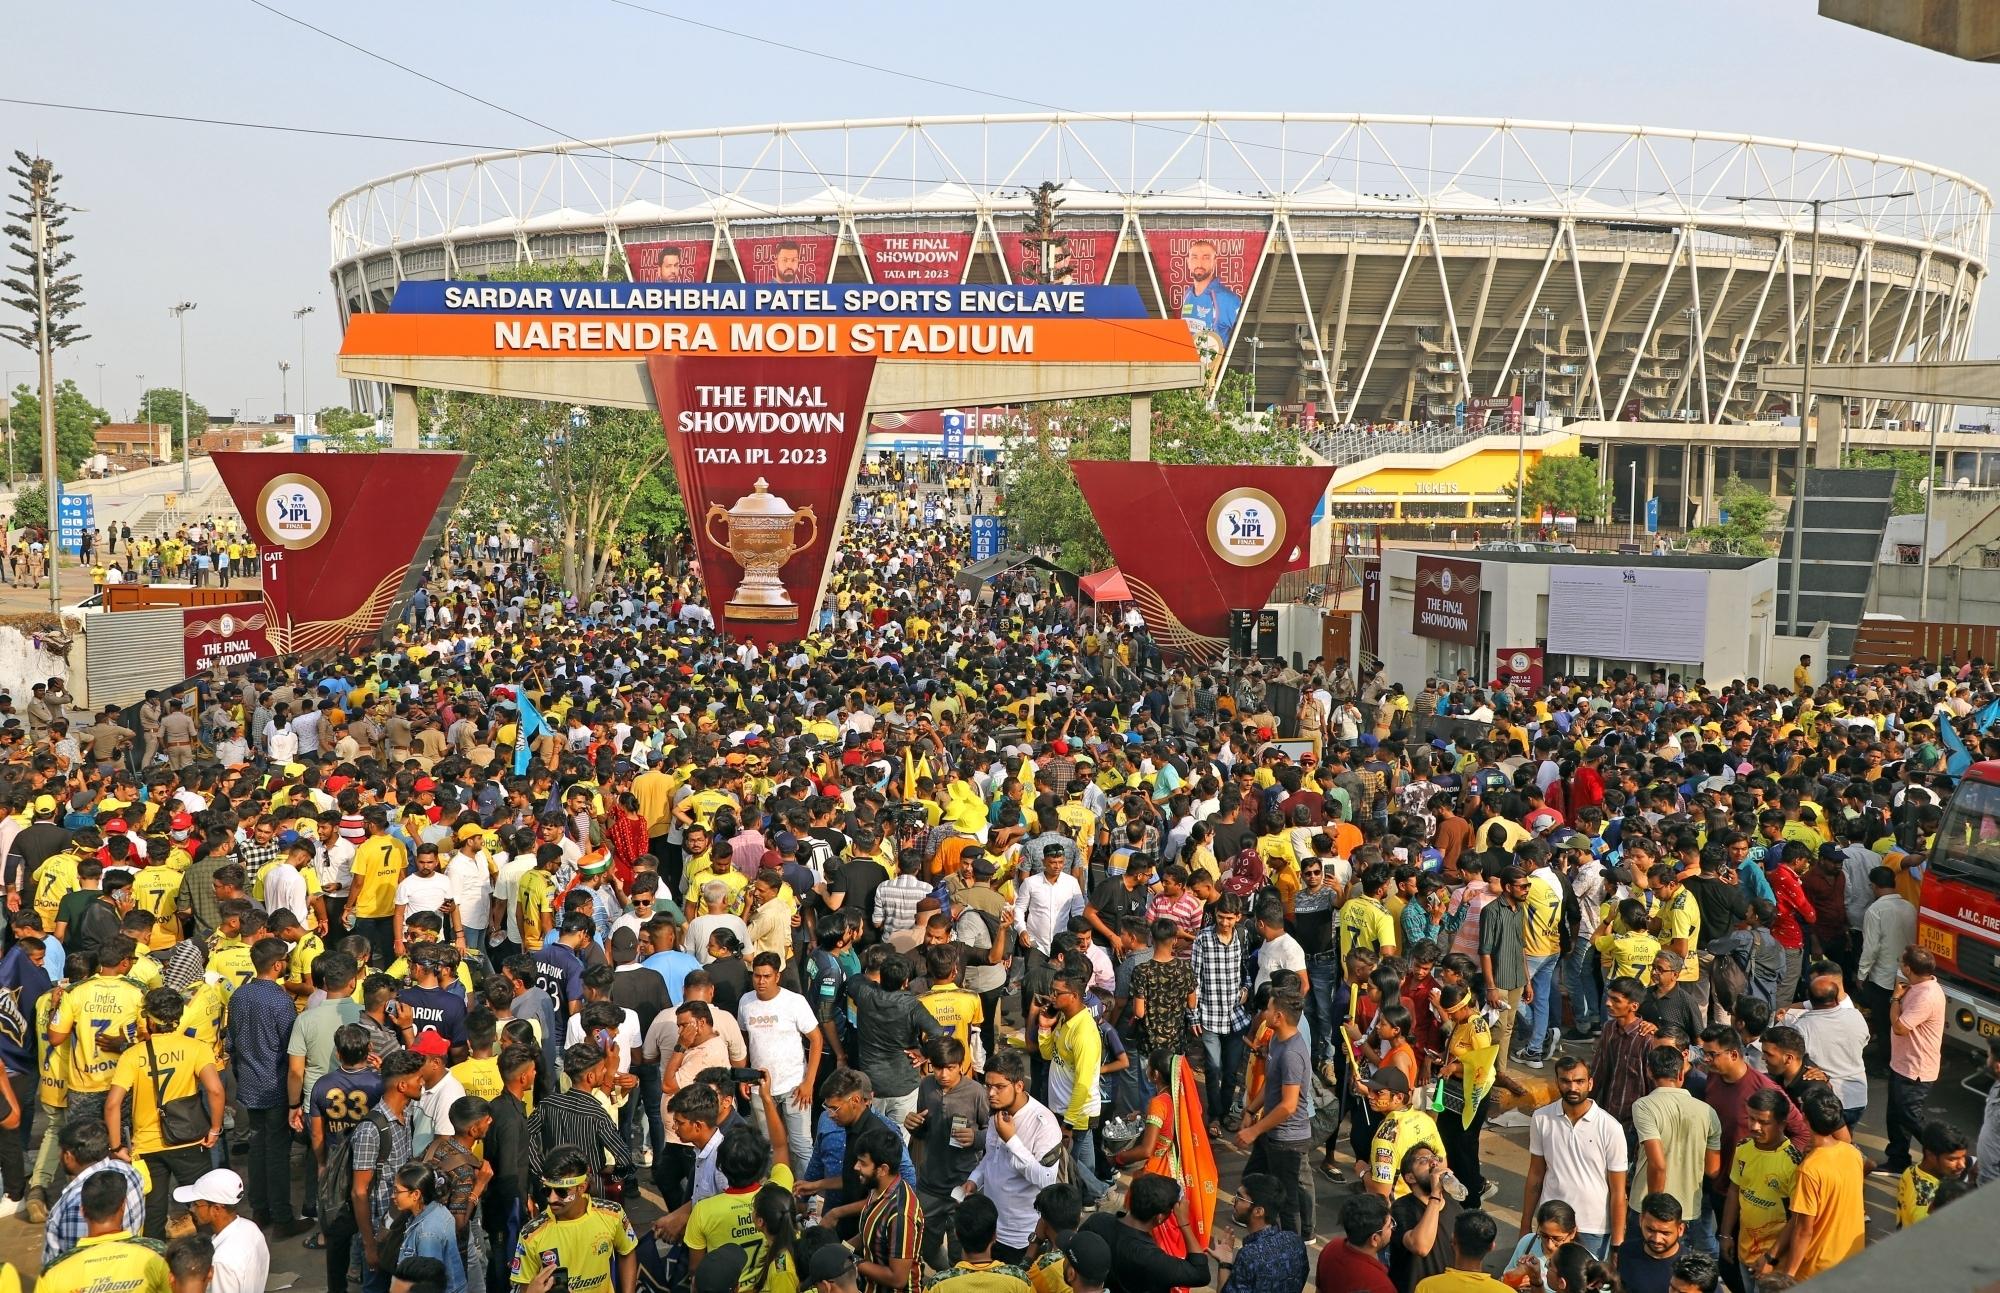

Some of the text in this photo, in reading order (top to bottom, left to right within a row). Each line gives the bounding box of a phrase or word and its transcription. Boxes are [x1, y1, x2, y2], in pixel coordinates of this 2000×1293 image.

[884, 238, 950, 250] THE FINAL
[876, 251, 959, 263] SHOWDOWN
[884, 270, 949, 279] TATA IPL 2023
[445, 287, 1085, 313] SARDAR VALLABHBHAI PATEL SPORTS ENCLAVE
[495, 321, 1034, 354] NARENDRA MODI STADIUM
[695, 385, 828, 408] THE FINAL
[677, 410, 845, 434] SHOWDOWN
[694, 447, 828, 465] TATA IPL 2023
[1416, 482, 1459, 494] TICKETS
[289, 508, 312, 522] IPL
[1241, 524, 1265, 538] IPL
[264, 551, 284, 562] GATE
[270, 562, 277, 581] 1
[1369, 582, 1376, 601] 1
[1427, 597, 1464, 615] THE FINAL
[1421, 612, 1469, 632] SHOWDOWN
[202, 639, 251, 656] THE FINAL
[381, 844, 393, 867] 7
[377, 869, 397, 877] DHONI
[44, 872, 56, 897] 7
[150, 889, 165, 914] 7
[1958, 907, 1982, 925] A.M.C.
[1633, 945, 1649, 953] India
[94, 991, 116, 1004] India
[84, 1001, 123, 1015] Cements
[936, 1006, 955, 1015] India
[138, 1053, 185, 1069] DONI
[147, 1067, 176, 1106] 7
[472, 1076, 493, 1086] India
[326, 1087, 369, 1121] 33
[737, 1214, 753, 1227] Ind
